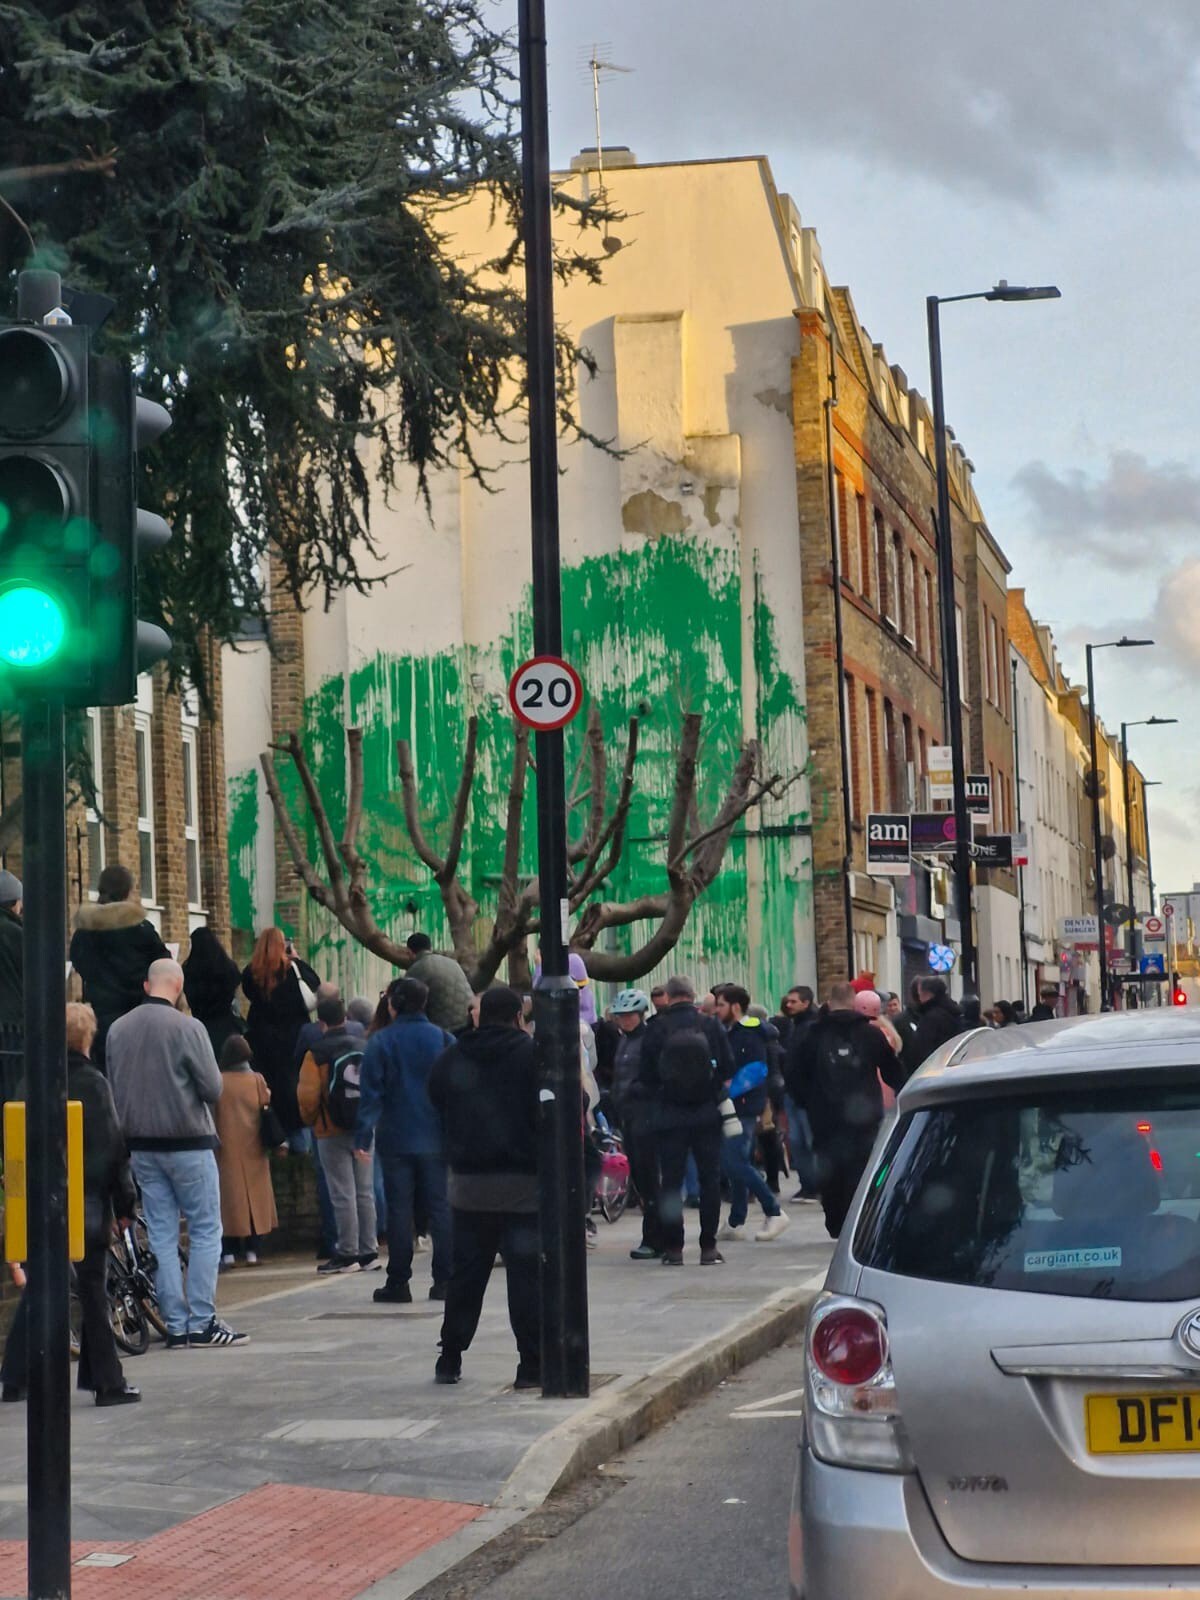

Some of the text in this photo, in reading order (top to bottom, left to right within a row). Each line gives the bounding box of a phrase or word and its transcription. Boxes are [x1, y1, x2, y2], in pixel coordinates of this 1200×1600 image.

[522, 677, 572, 708] 20
[870, 823, 908, 841] am
[1026, 1249, 1119, 1267] cargiant.co.uk
[1116, 1395, 1200, 1443] DF1
